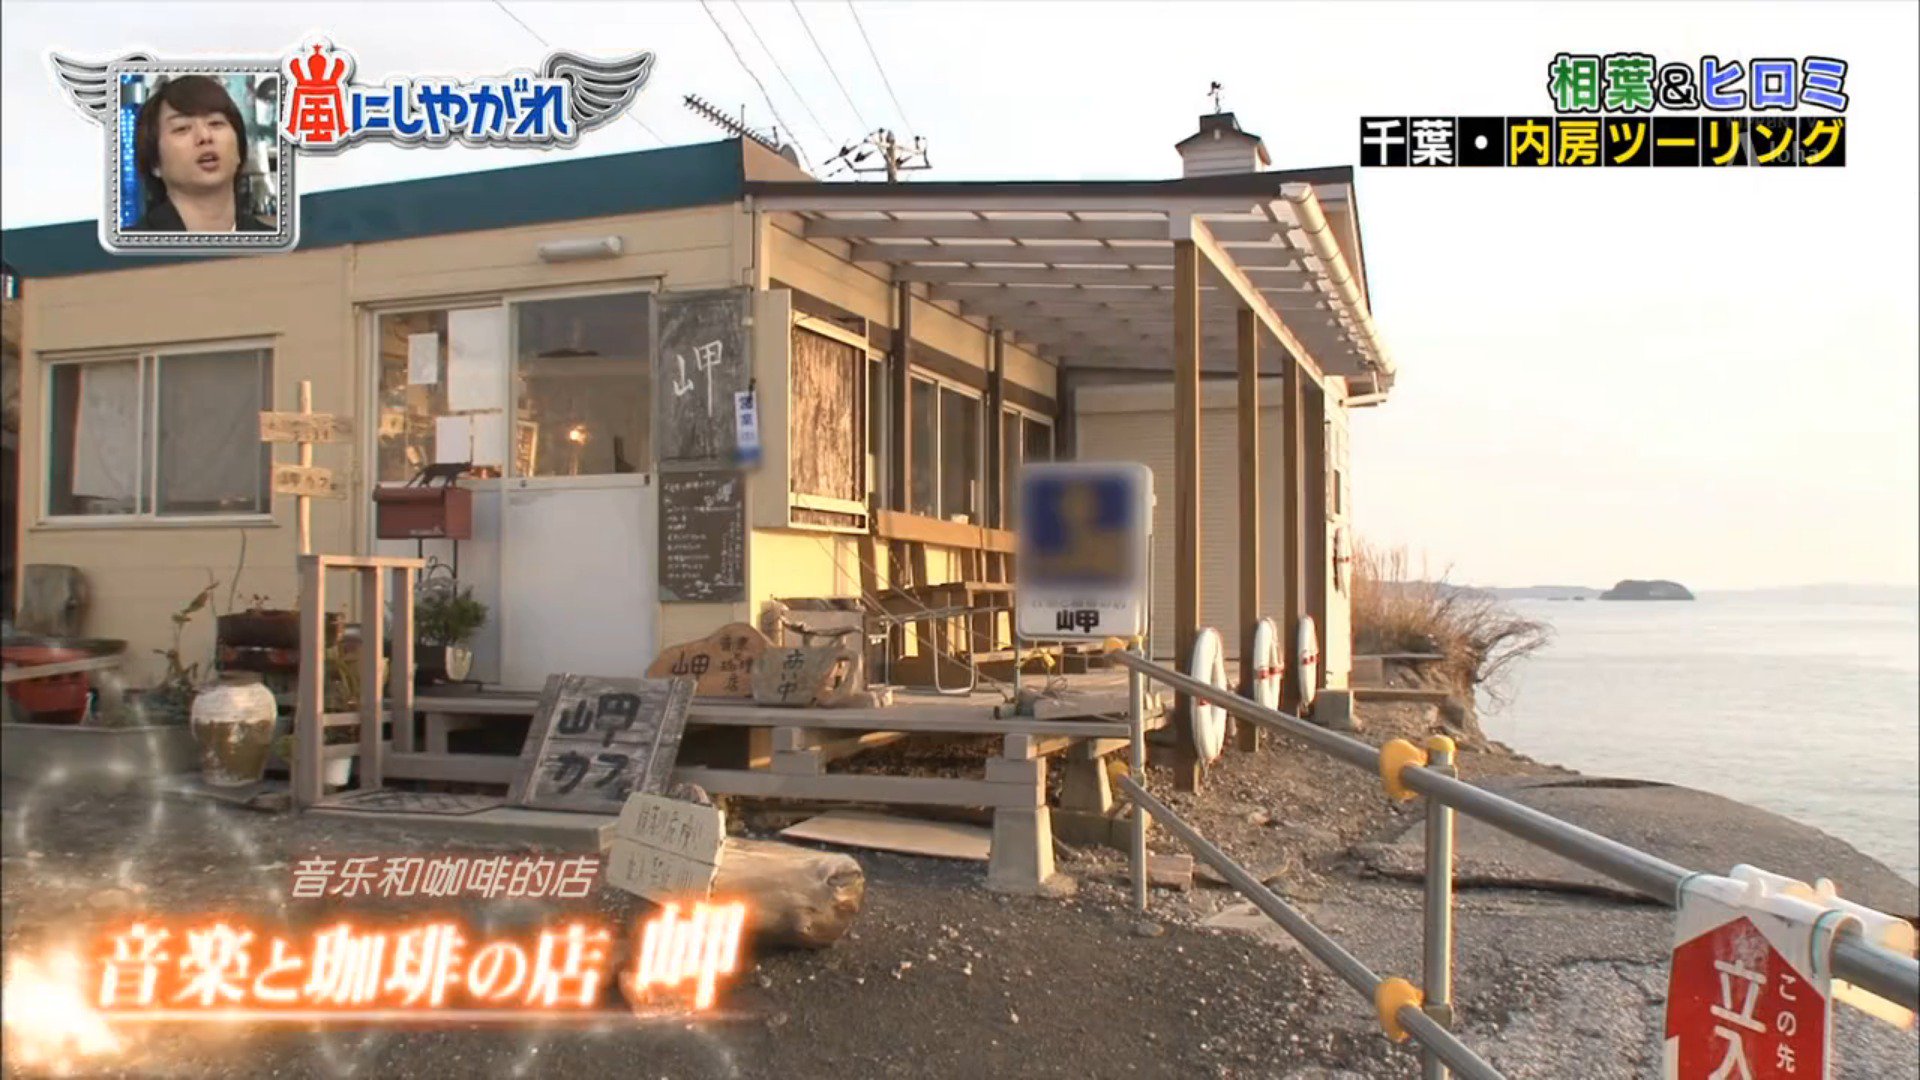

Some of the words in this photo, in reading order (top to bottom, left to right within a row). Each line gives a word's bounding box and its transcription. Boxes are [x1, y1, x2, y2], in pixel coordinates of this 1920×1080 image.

[672, 339, 724, 418] 岬
[1055, 609, 1100, 633] 岬
[556, 691, 642, 747] 岬
[1775, 972, 1798, 1074] この先
